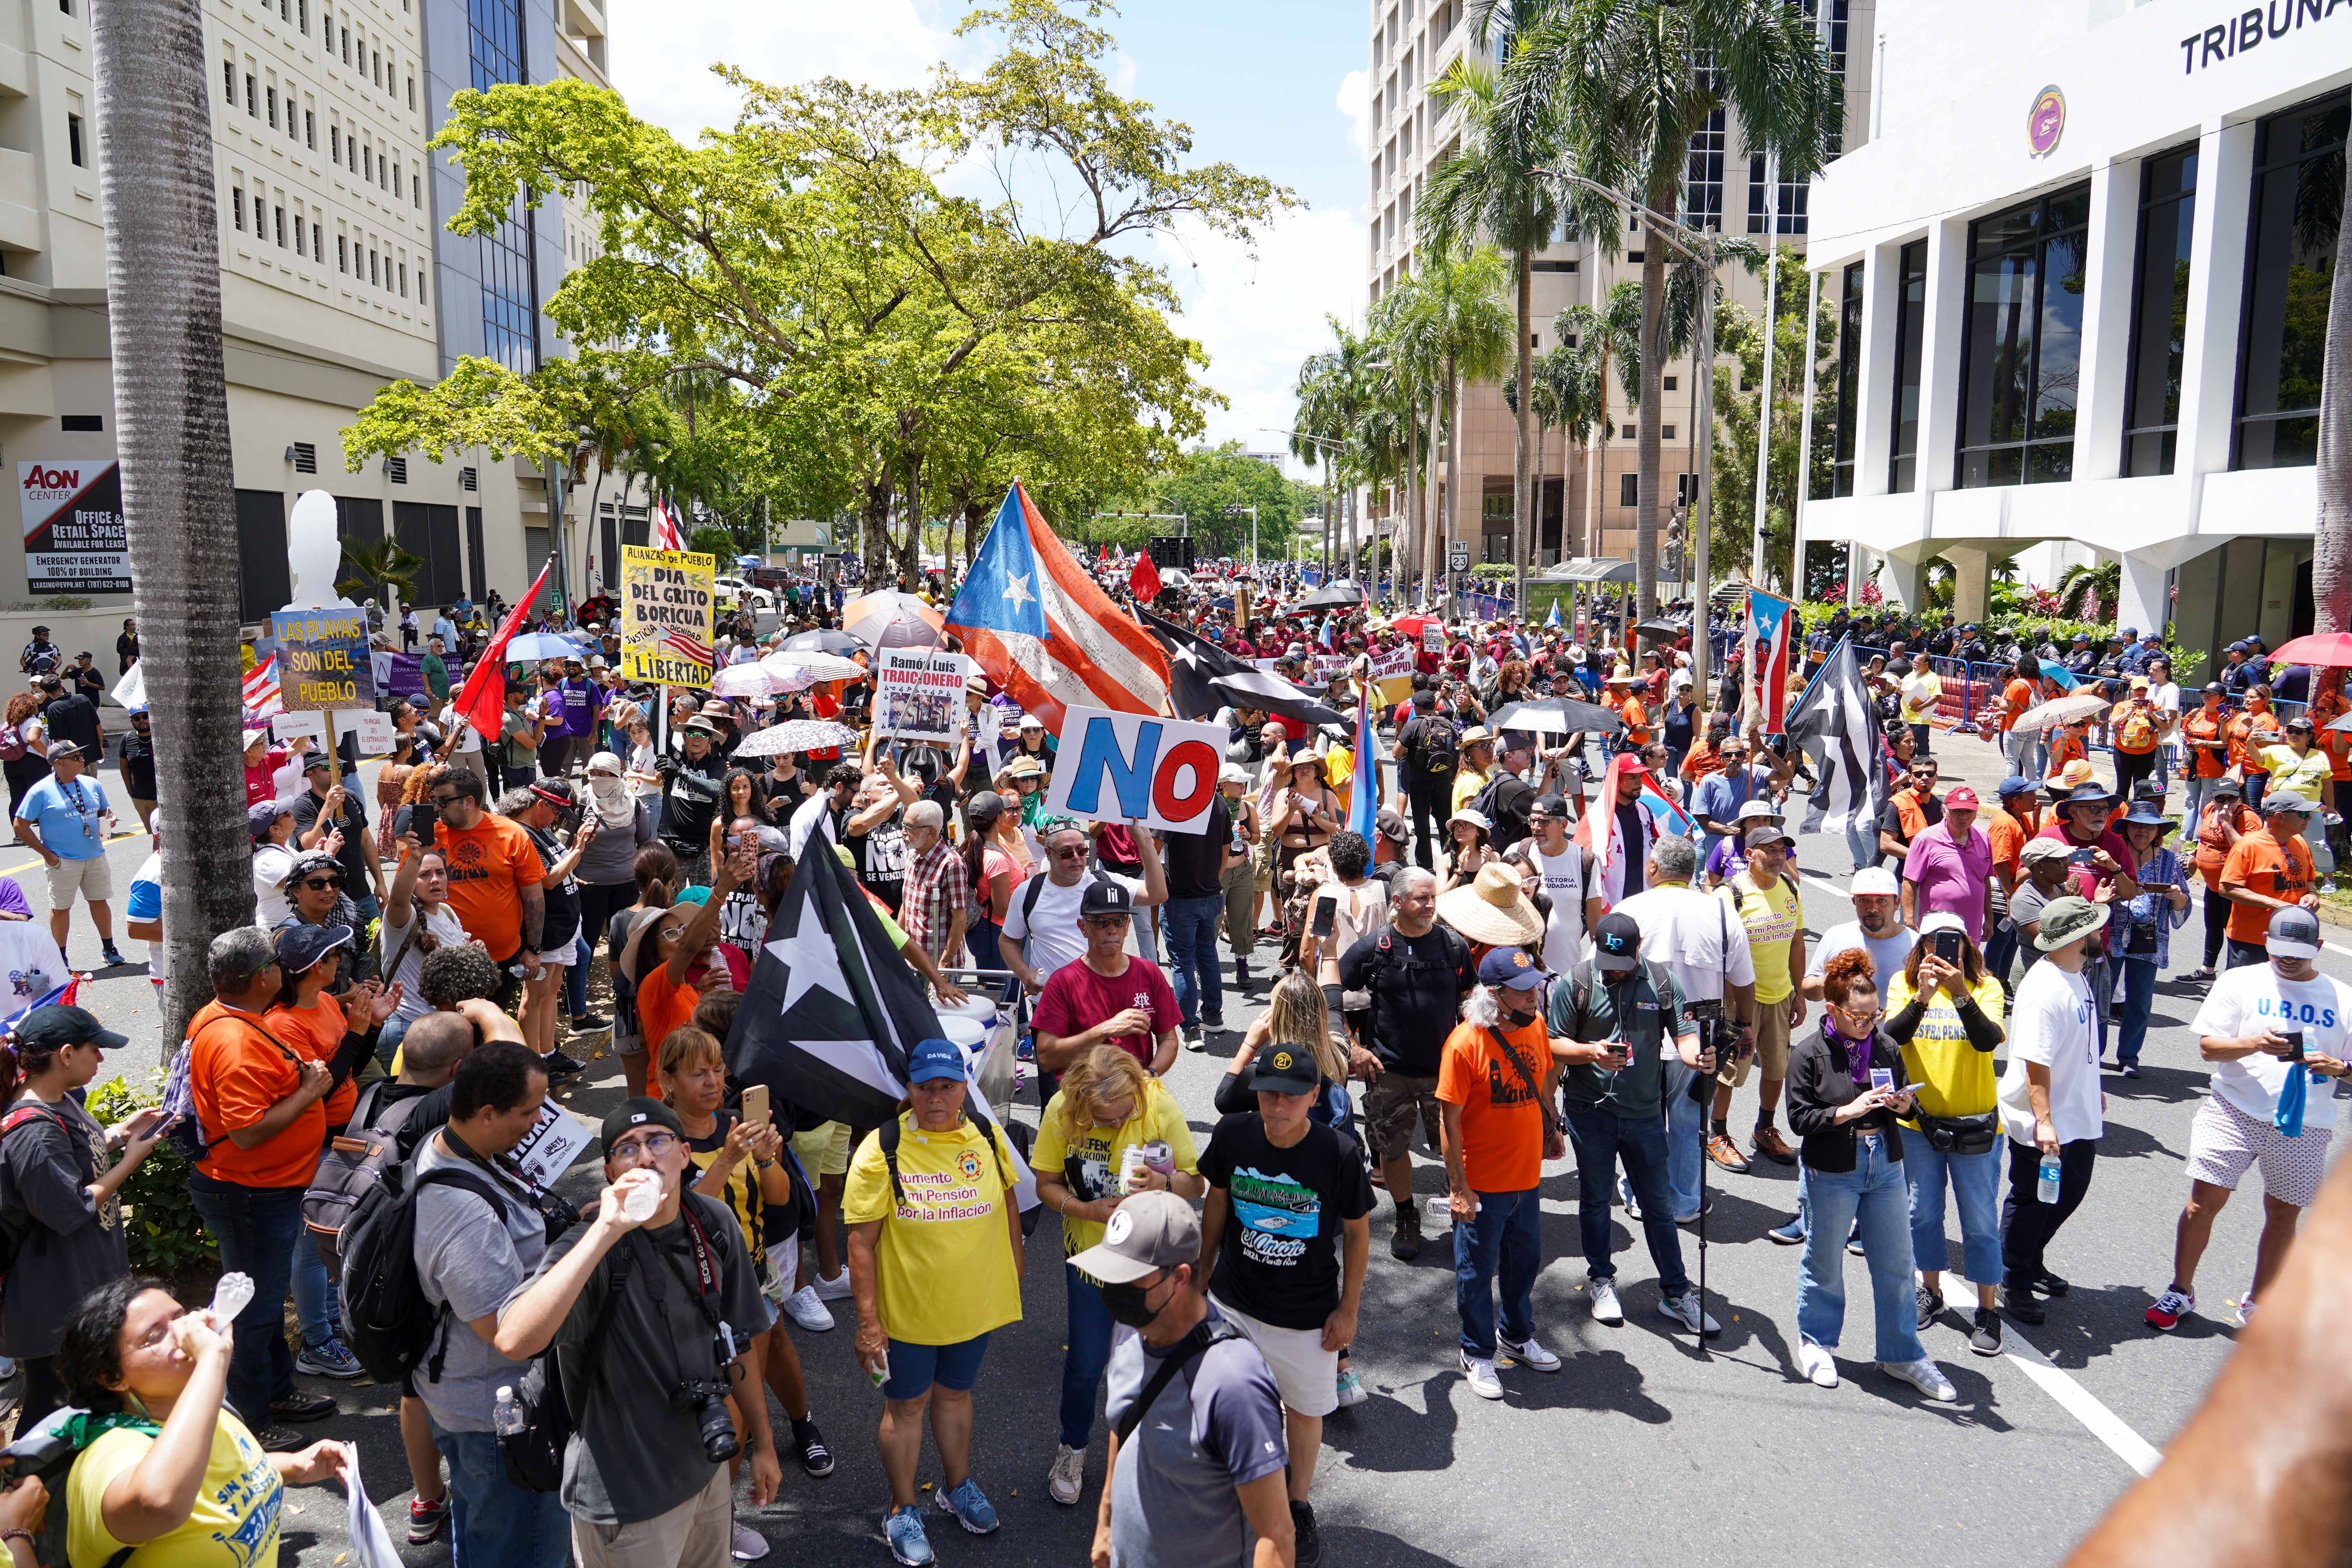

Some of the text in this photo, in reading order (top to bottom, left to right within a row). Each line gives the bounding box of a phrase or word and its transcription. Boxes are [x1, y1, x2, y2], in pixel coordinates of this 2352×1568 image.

[29, 491, 71, 500] CENTER
[75, 510, 123, 524] OFFICE &
[52, 523, 125, 539] RETAIL SPACE
[54, 539, 126, 549] AVAILABLE FOR LEASE
[1453, 542, 1467, 550] INT
[36, 556, 121, 565] EMERGENCY GENERATOR
[681, 553, 712, 566] PUEBLO
[1453, 557, 1466, 566] 23
[47, 567, 67, 576] 100%
[79, 568, 112, 576] BUILDING
[632, 583, 659, 601] DEL
[277, 617, 360, 642] LAS PLAYAS
[292, 650, 354, 672] SON DEL
[1395, 652, 1405, 661] de
[933, 660, 956, 673] Luis
[1385, 661, 1411, 675] (APPU)
[299, 681, 356, 702] PUEBLO
[1066, 717, 1219, 822] NO
[2301, 779, 2318, 787] DIGNO
[866, 873, 877, 882] SE
[736, 892, 756, 903] PLAY
[1746, 913, 1782, 924] Aumento
[1767, 921, 1794, 932] Pensión
[1773, 931, 1794, 940] Inflac
[2258, 998, 2335, 1028] U.B.O.S
[1913, 1024, 1969, 1041] ESTRA PENS
[927, 1053, 952, 1061] DAVIDA
[1277, 1057, 1287, 1066] 21
[898, 1171, 952, 1183] Aumento
[908, 1187, 977, 1201] mi Pensión
[897, 1202, 991, 1220] por la Inflación
[697, 1245, 705, 1258] 6D
[1254, 1233, 1307, 1257] Ancón
[1261, 1255, 1283, 1266] Puerto
[1283, 1257, 1297, 1266] Rico
[701, 1259, 711, 1284] EOS
[217, 1479, 241, 1504] SIN
[226, 1502, 239, 1517] Y
[257, 1516, 281, 1556] PARALIZ
